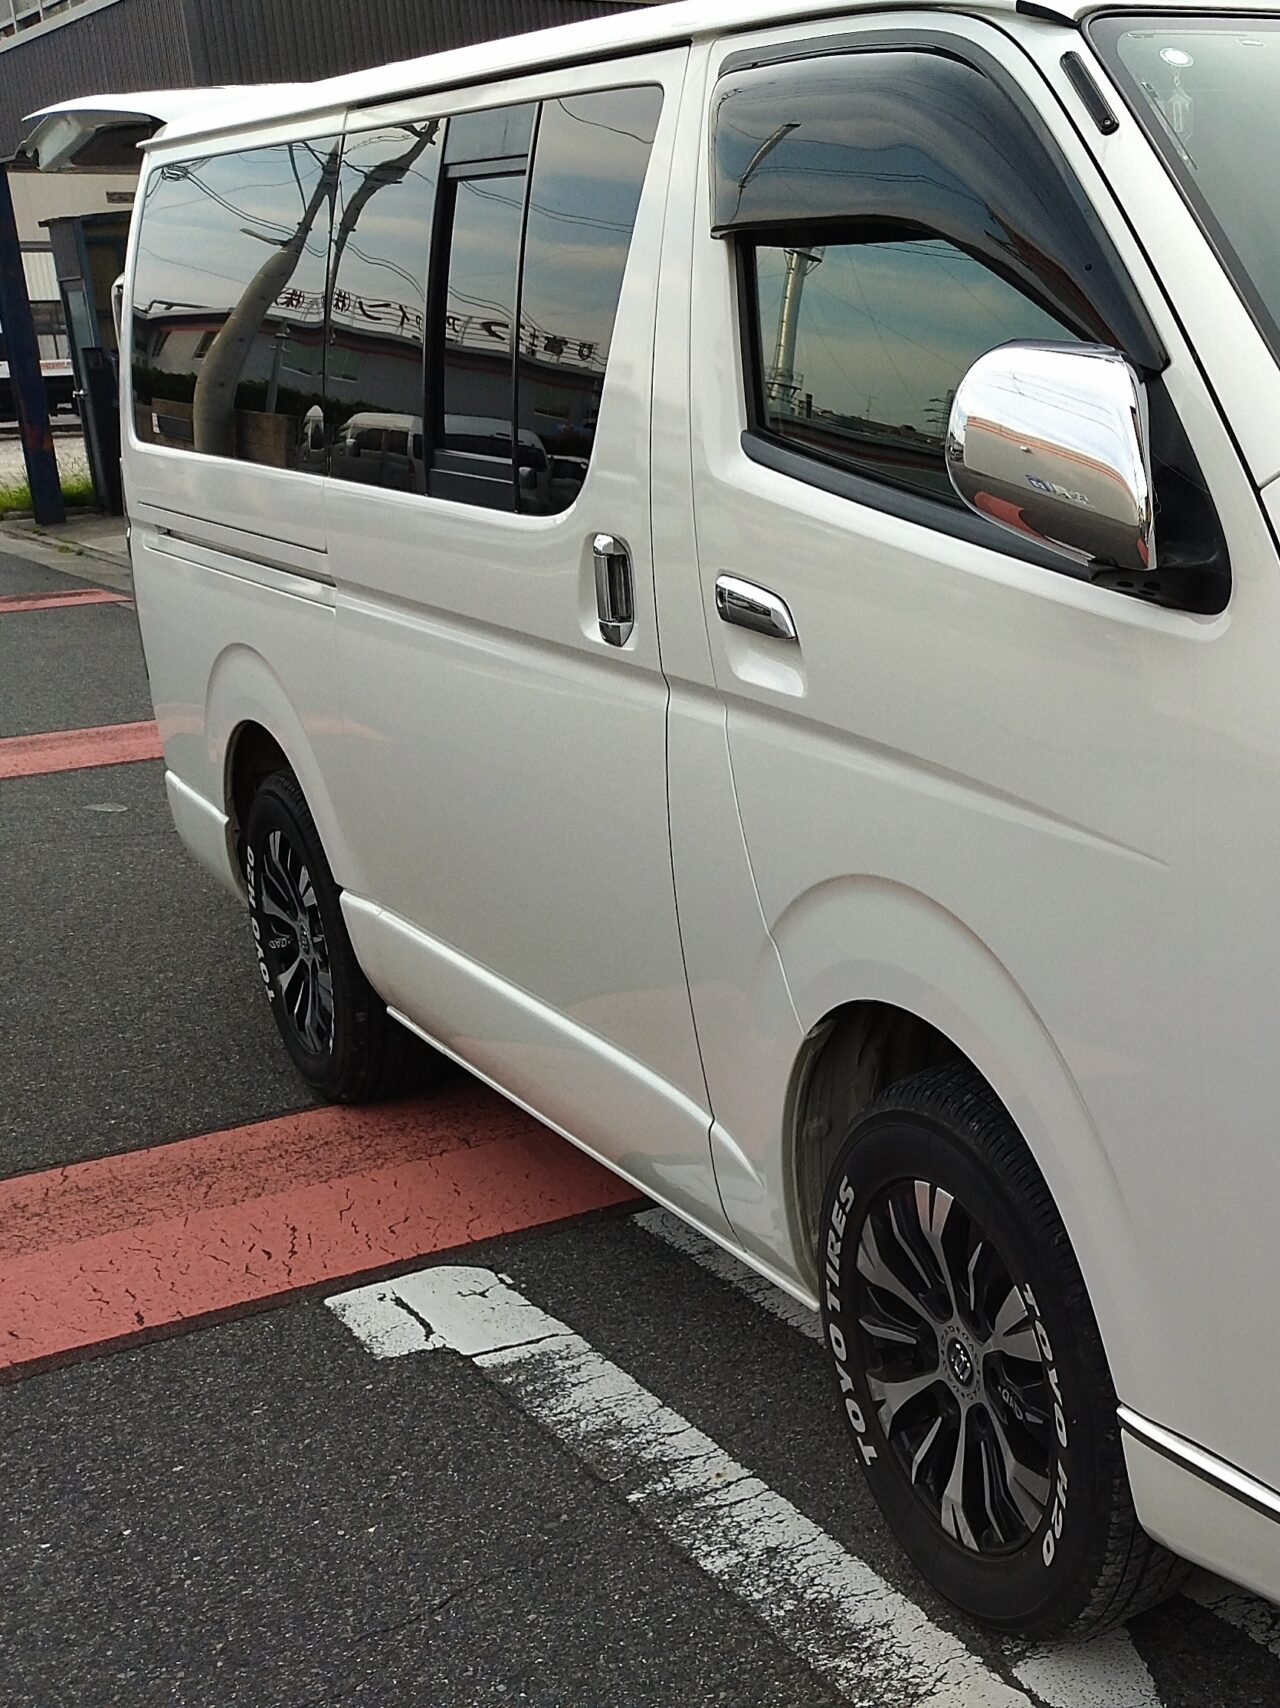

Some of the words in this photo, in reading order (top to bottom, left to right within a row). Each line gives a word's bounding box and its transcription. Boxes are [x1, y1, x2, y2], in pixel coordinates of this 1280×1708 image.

[251, 917, 275, 1002] TOYO
[826, 1175, 856, 1312] TIRES
[829, 1323, 878, 1466] TOYO
[1022, 1283, 1067, 1448] TOYO
